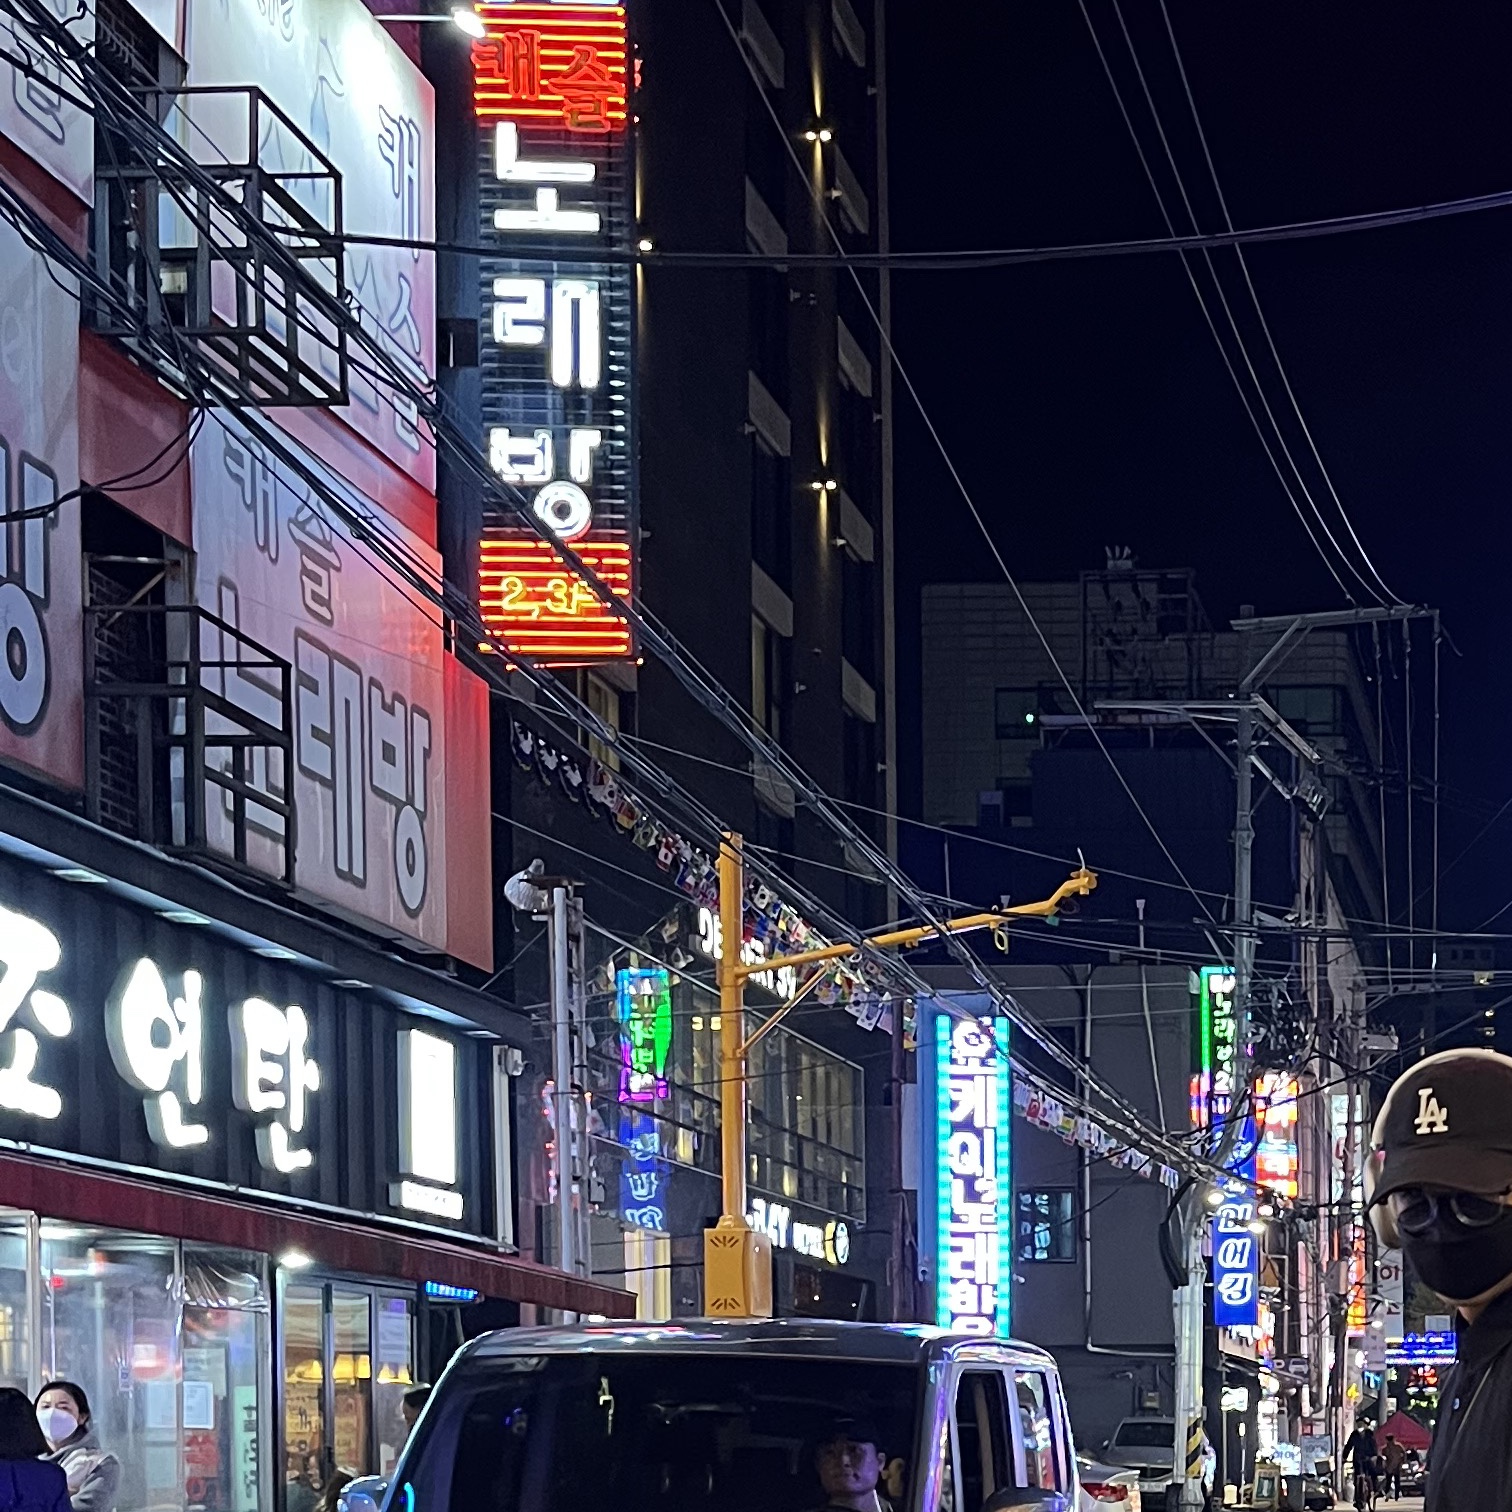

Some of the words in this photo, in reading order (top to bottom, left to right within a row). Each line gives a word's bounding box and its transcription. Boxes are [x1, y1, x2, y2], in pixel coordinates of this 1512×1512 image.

[470, 28, 626, 133] 캐슬
[490, 121, 602, 538] 노래방
[223, 429, 342, 627] 캐슬
[1414, 1088, 1449, 1135] LA
